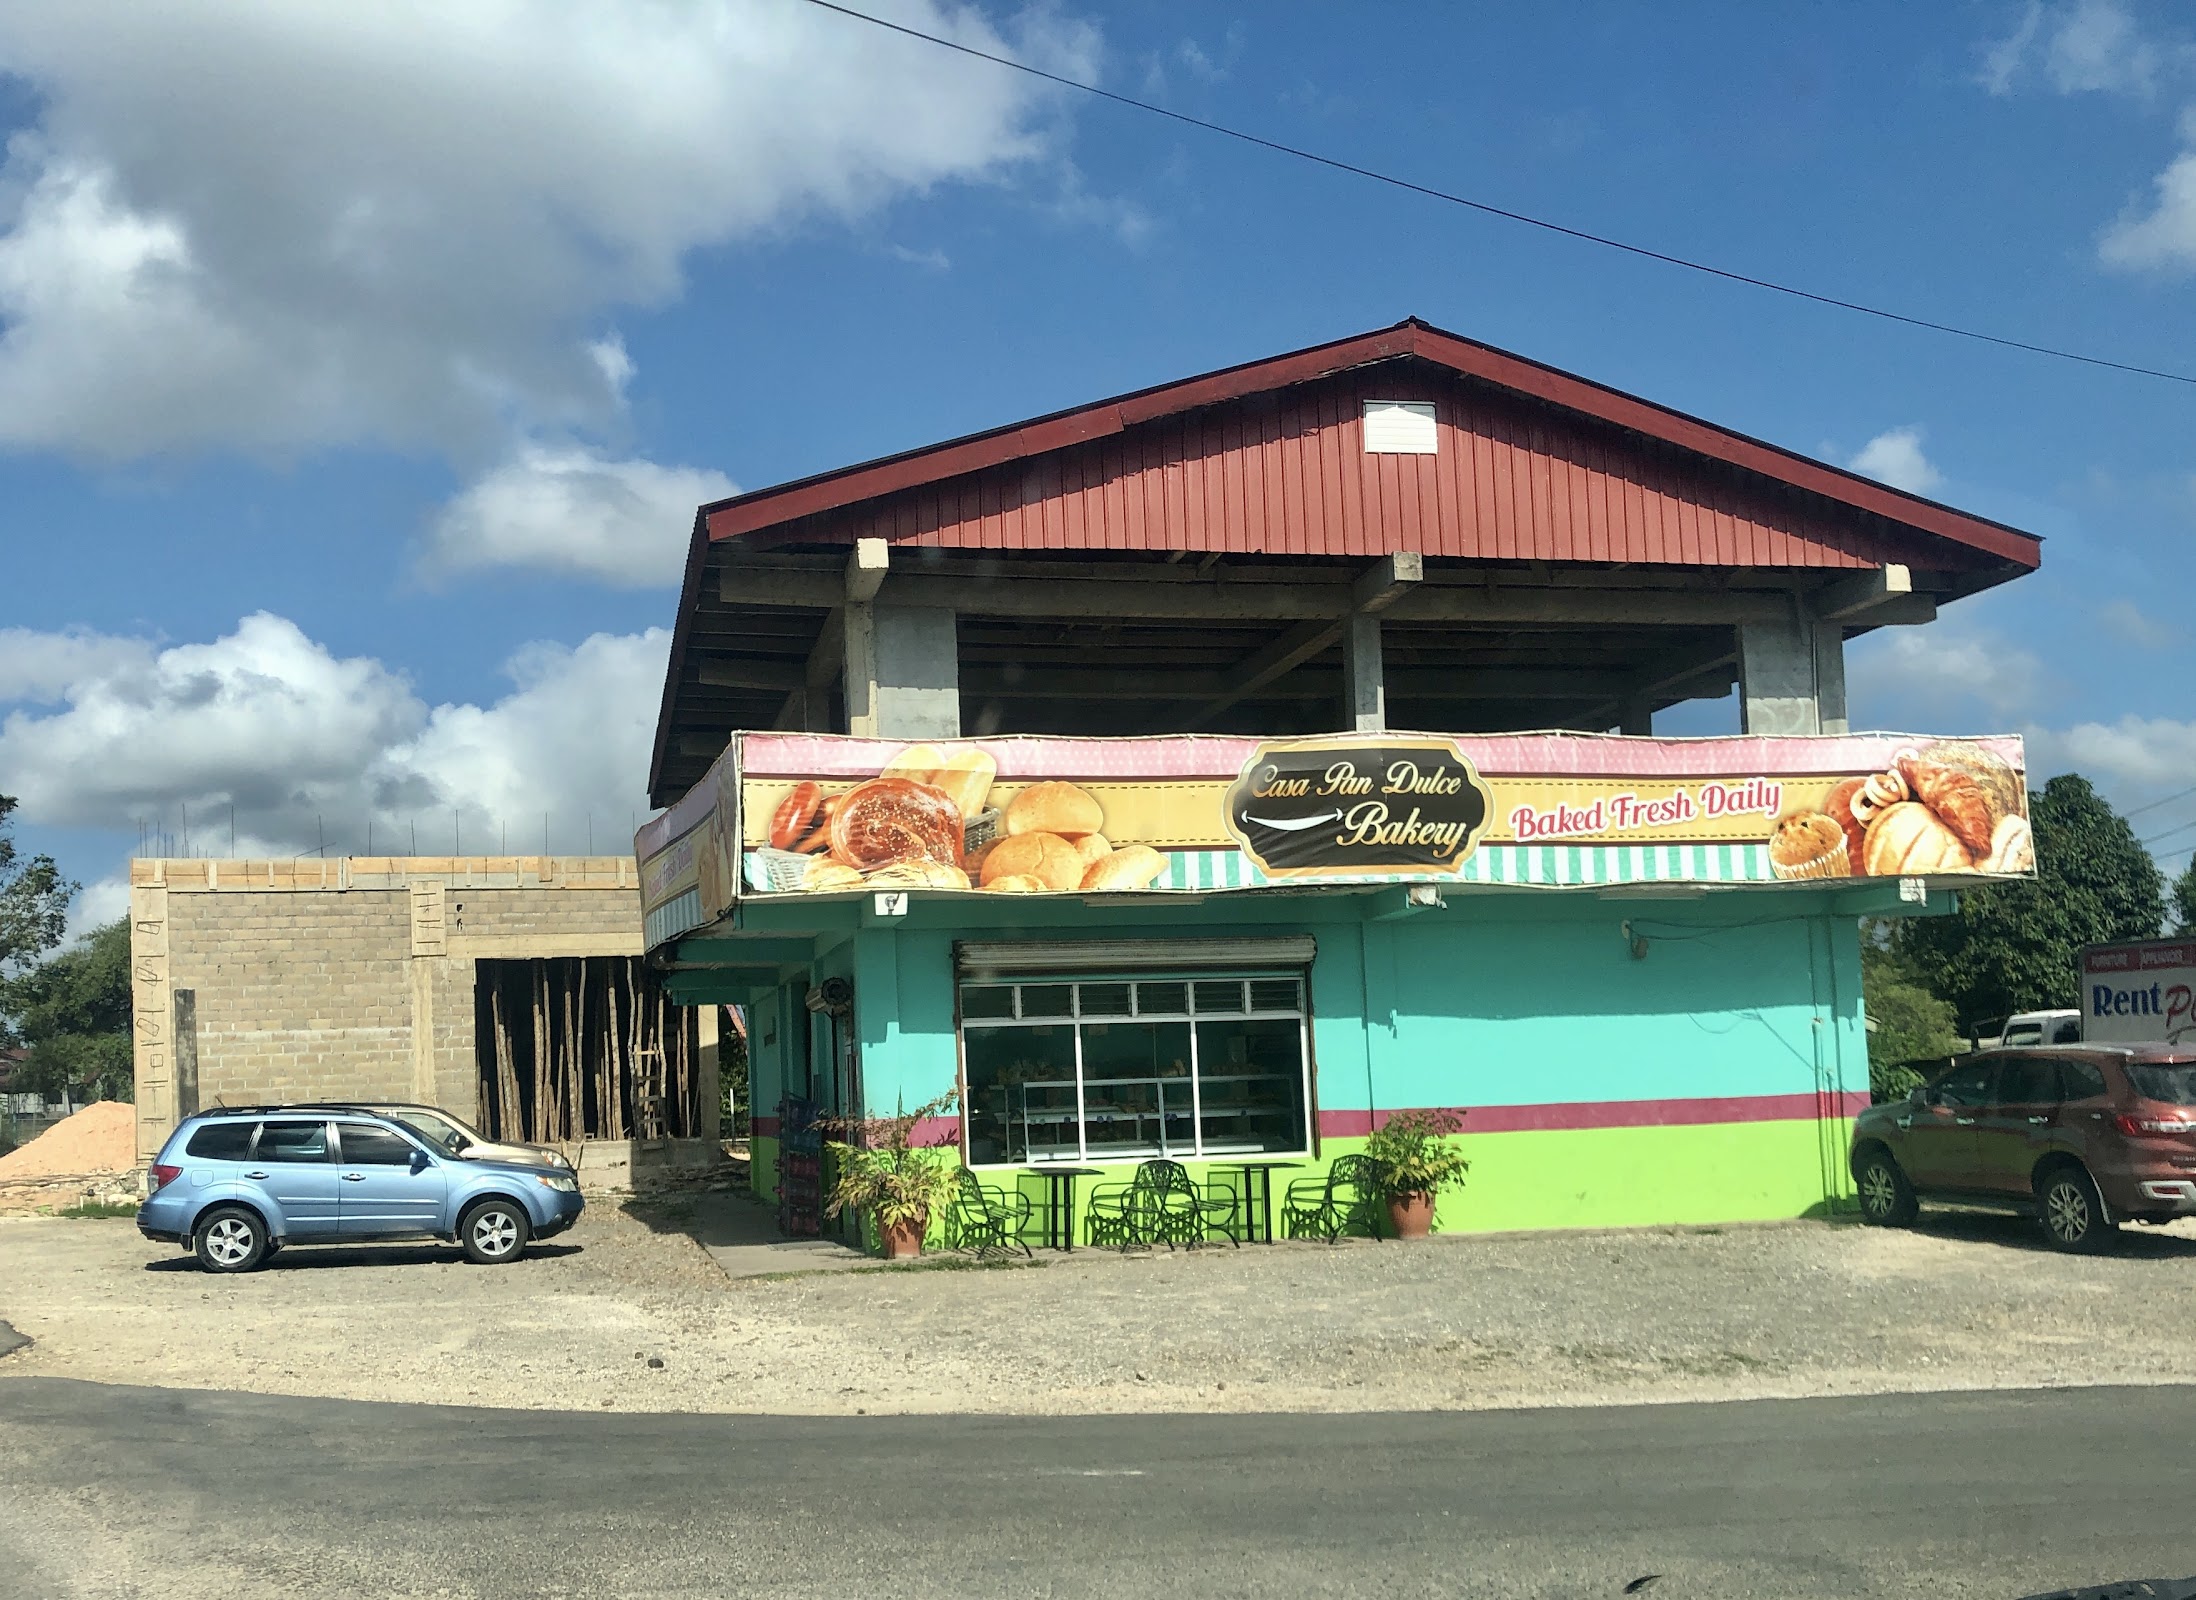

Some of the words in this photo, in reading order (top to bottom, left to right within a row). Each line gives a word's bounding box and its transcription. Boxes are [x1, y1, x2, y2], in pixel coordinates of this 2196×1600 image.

[1252, 764, 1311, 798] Casa
[1315, 761, 1375, 796] Pan
[1380, 760, 1462, 796] Dulce
[1335, 800, 1467, 858] Bakery
[1511, 801, 1606, 839] Baked
[1610, 792, 1696, 827] Fresh
[1701, 780, 1780, 816] Daily
[2092, 981, 2162, 1016] Rent
